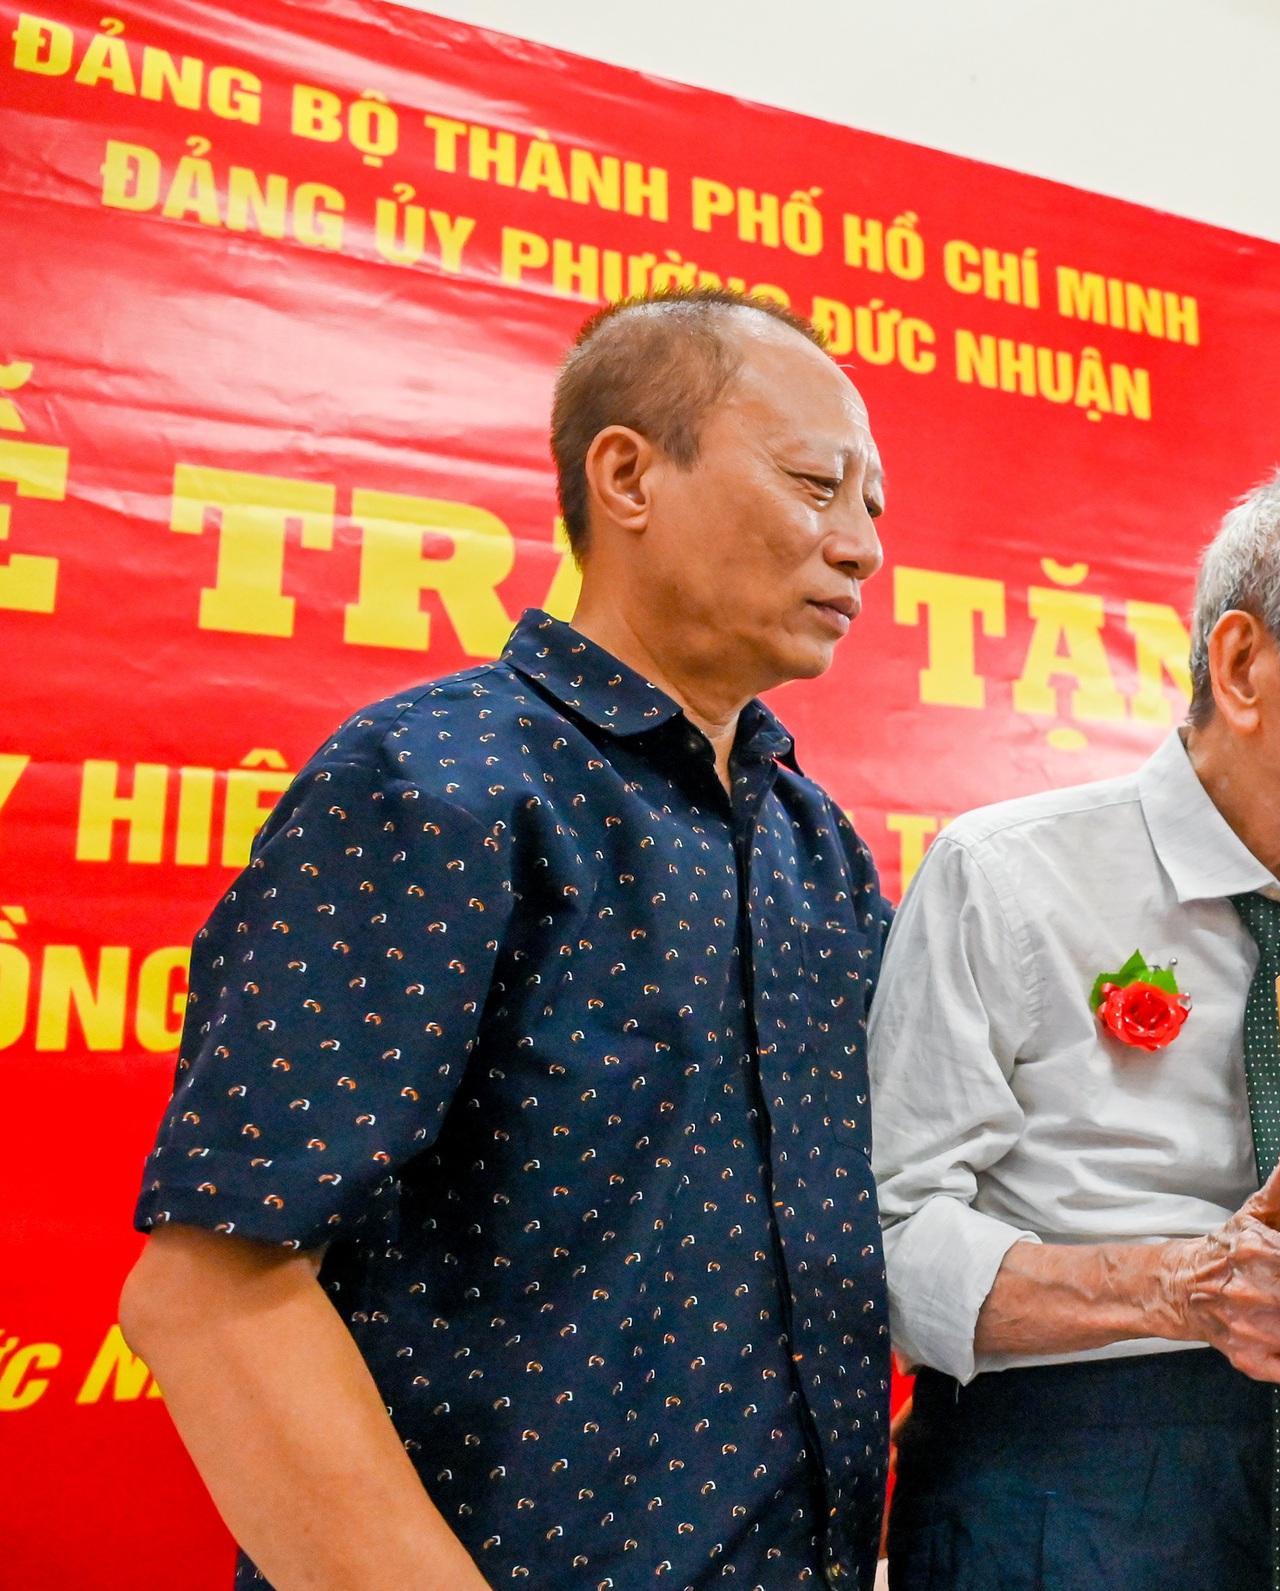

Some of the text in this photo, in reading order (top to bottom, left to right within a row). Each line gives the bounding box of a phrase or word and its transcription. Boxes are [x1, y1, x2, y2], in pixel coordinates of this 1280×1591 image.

[12, 16, 1200, 347] ĐẢNG BỘ THÀNH PHỐ HỒ CHÍ MINH
[100, 135, 346, 251] ĐẢNG
[374, 182, 476, 275] ỦY
[811, 297, 937, 374] ĐỨC
[955, 329, 1152, 422] NHUẬN
[893, 557, 1195, 751] TẶN
